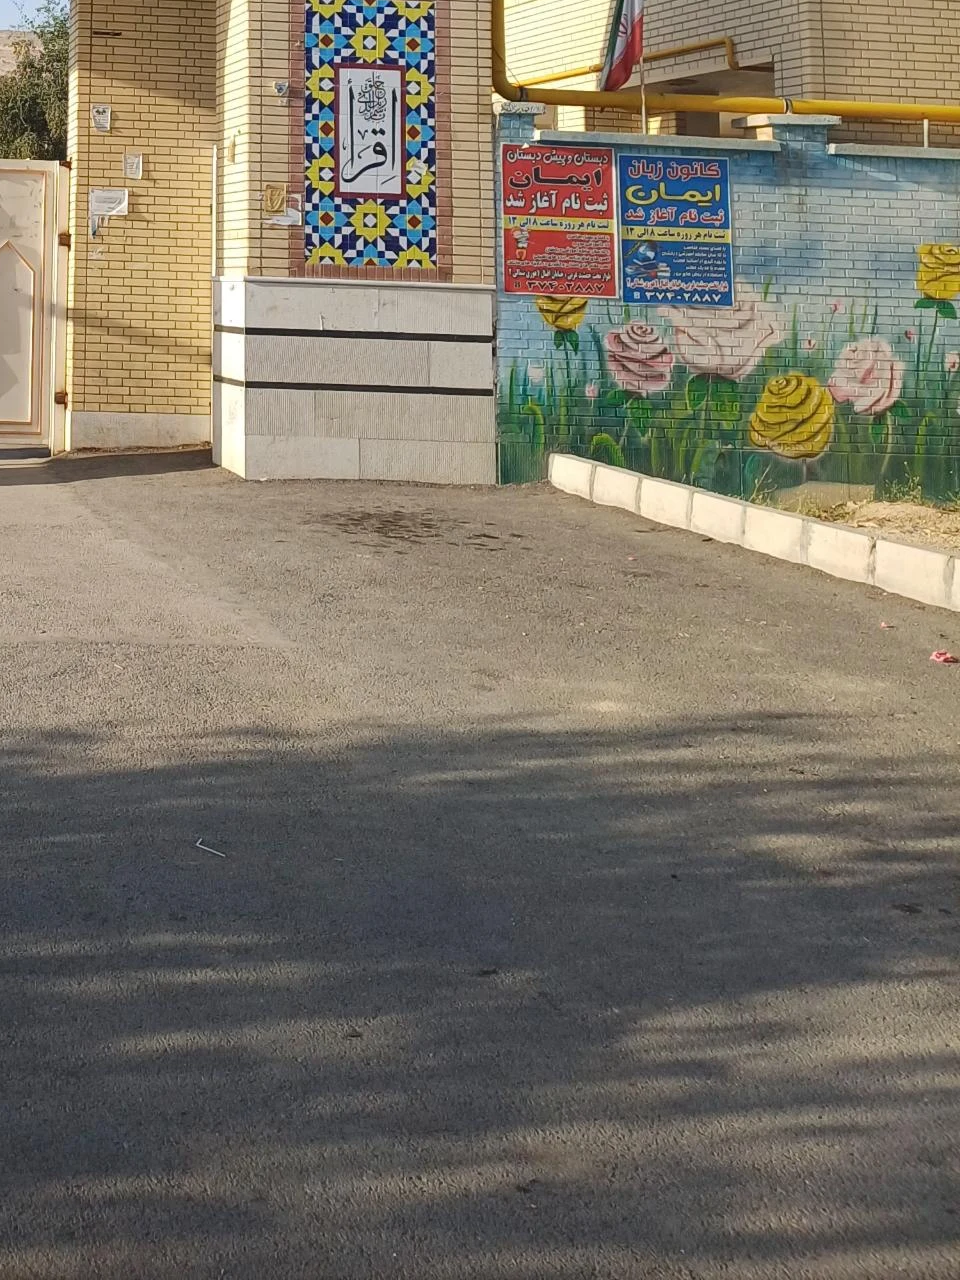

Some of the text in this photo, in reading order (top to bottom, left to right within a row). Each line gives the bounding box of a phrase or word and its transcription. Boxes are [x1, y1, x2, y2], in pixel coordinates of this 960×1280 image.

[507, 148, 542, 163] دبستان
[543, 149, 567, 166] پیش
[574, 151, 609, 166] دبستان
[508, 165, 603, 192] ایمان
[628, 160, 721, 182] کانون زبان
[505, 190, 609, 215] ثبت نام آغاز شد
[625, 181, 721, 206] ایمان
[625, 206, 725, 227] ثبت نام آغاز شد
